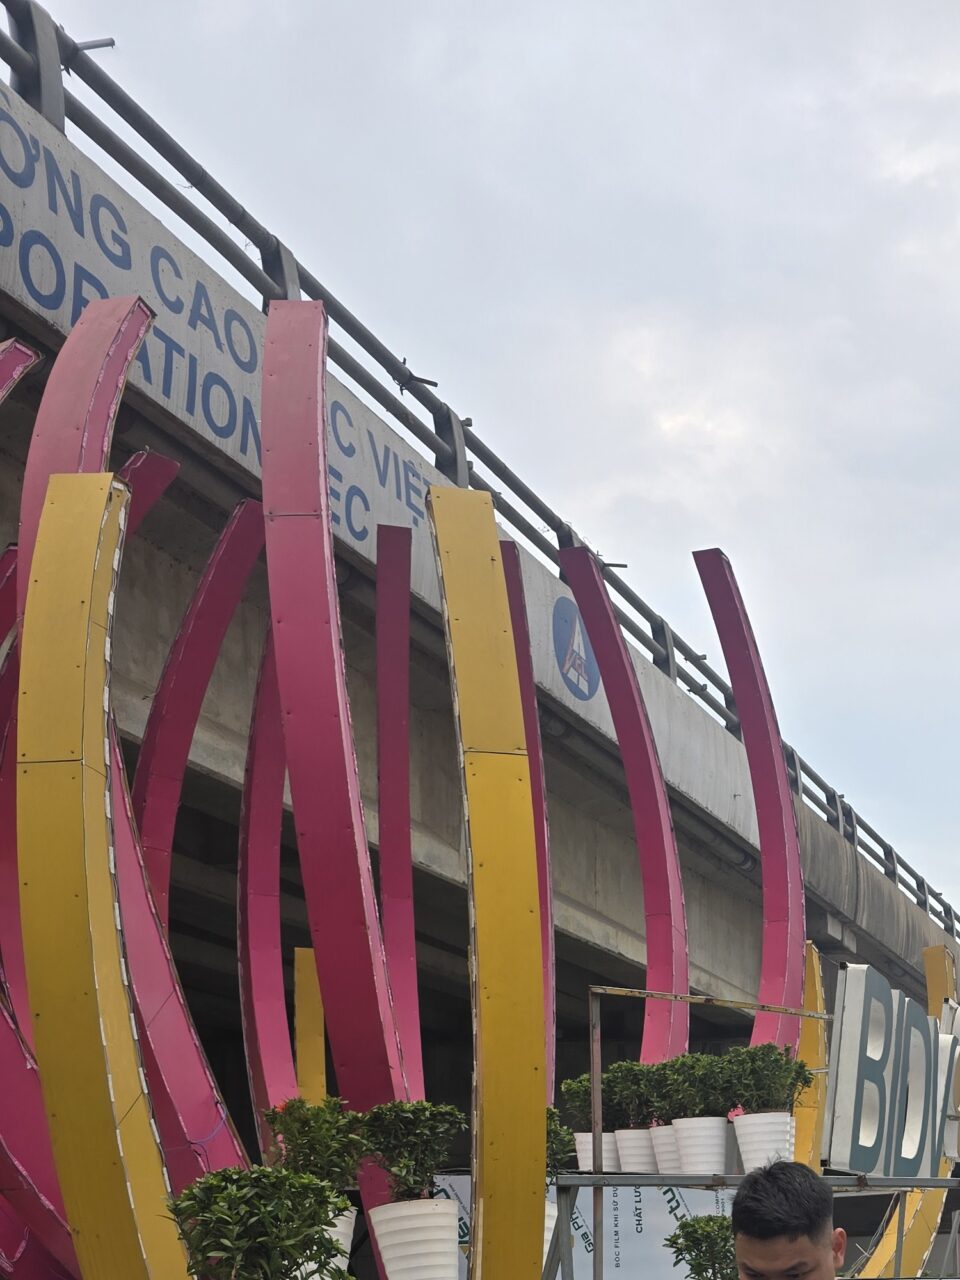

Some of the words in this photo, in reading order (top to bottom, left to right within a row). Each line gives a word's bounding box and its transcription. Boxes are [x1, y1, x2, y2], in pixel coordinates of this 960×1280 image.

[151, 245, 258, 374] CAO
[367, 429, 432, 527] VIỆ
[849, 965, 959, 1178] BIDV
[633, 1206, 643, 1234] CHẤT
